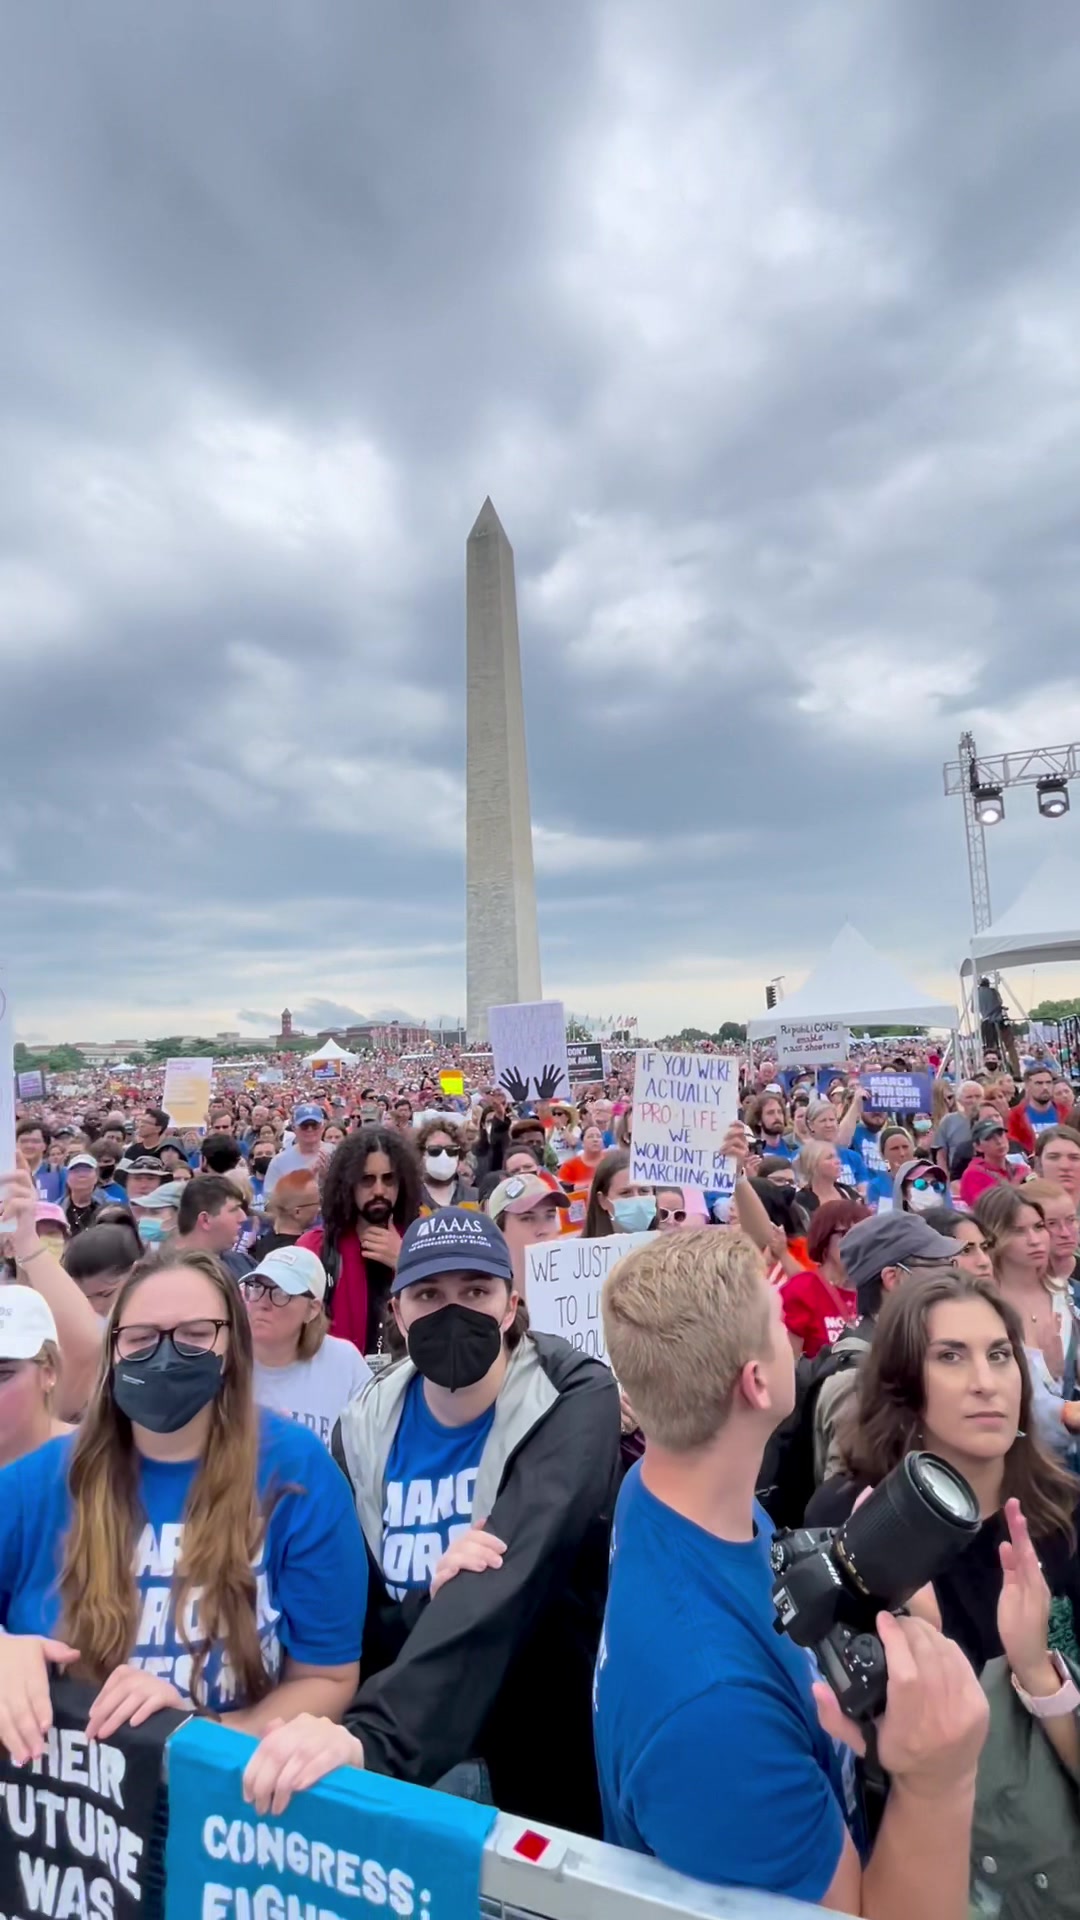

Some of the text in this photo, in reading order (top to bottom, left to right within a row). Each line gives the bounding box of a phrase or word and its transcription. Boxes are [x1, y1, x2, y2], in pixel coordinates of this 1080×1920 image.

[567, 1047, 587, 1056] DON'T
[804, 1042, 840, 1051] shooters
[643, 1053, 731, 1081] IF YOU WERE
[645, 1078, 721, 1106] ACTUALLY
[870, 1077, 912, 1086] MARCH
[872, 1087, 920, 1097] FOR OUR
[872, 1097, 904, 1107] LIVES
[669, 1128, 692, 1143] WE
[712, 1151, 728, 1169] BE
[633, 1161, 734, 1188] MARCHING NOW
[435, 1217, 482, 1233] AAAS
[530, 1245, 611, 1282] WE JUST
[555, 1290, 600, 1328] TO LI
[383, 1467, 479, 1527] ARC
[383, 1529, 443, 1582] OR
[12, 1727, 126, 1810] HEIR
[0, 1781, 144, 1901] UTURE
[19, 1850, 115, 1920] WAS
